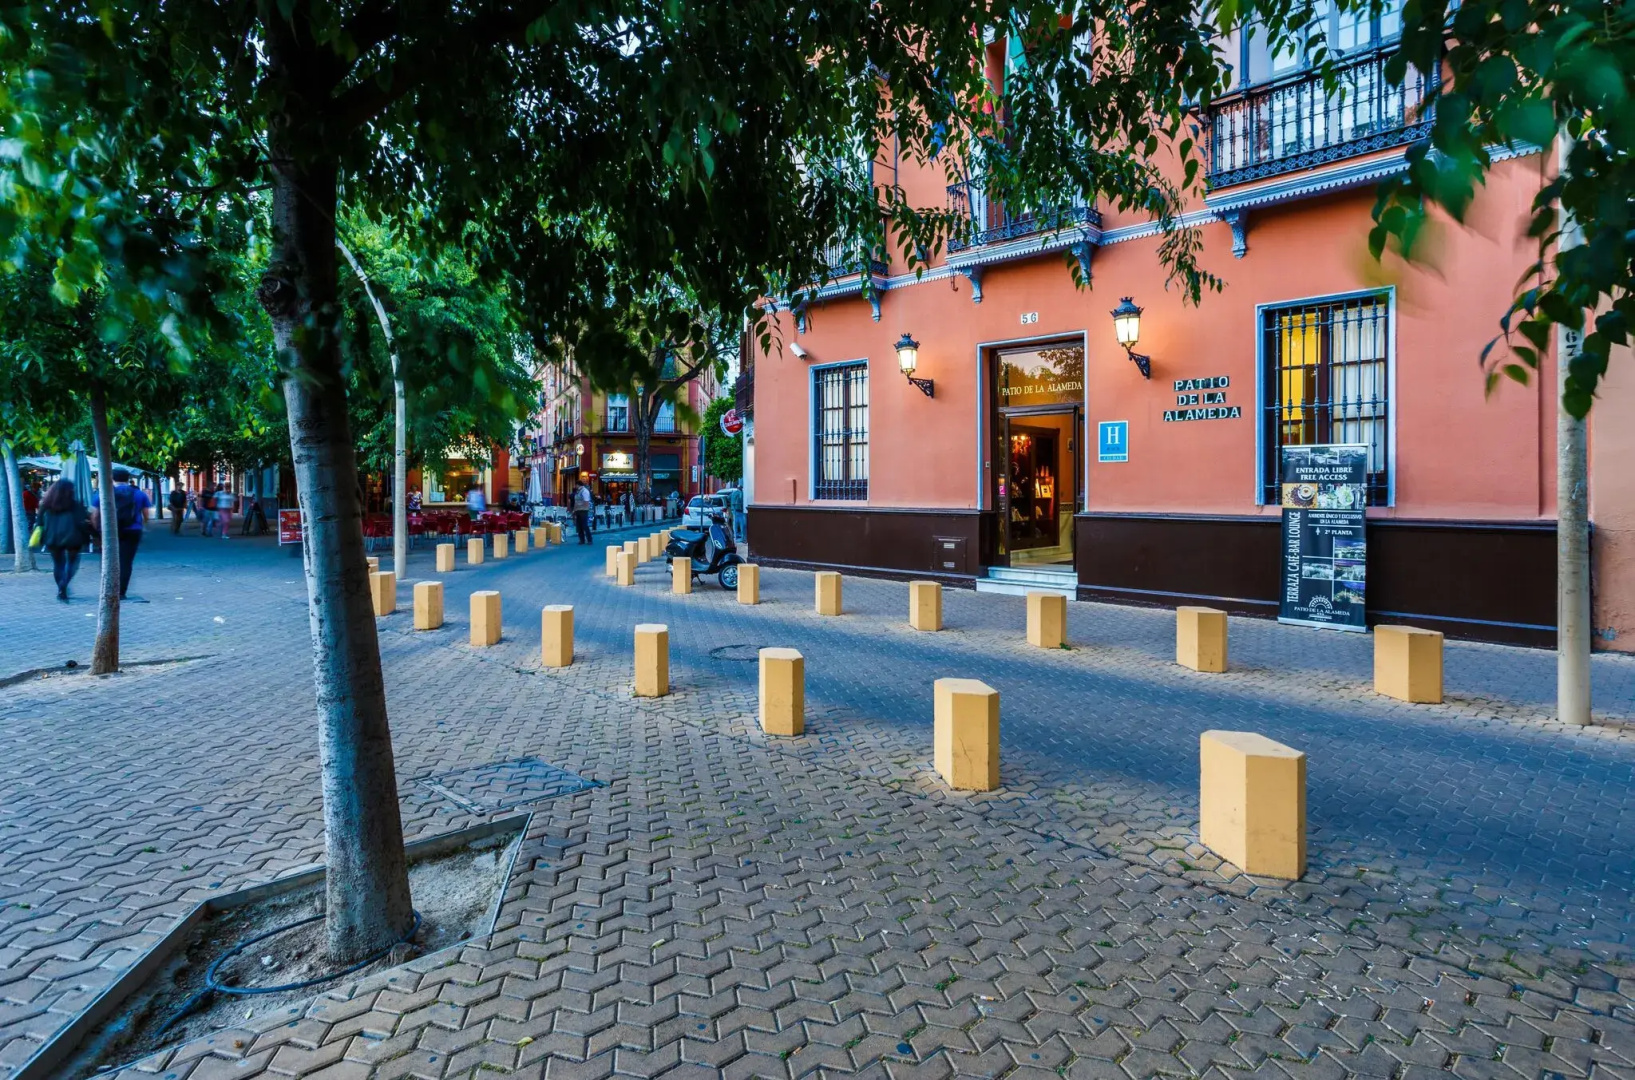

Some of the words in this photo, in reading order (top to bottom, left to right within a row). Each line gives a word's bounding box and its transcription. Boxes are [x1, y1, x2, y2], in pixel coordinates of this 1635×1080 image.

[1022, 312, 1037, 324] 56
[1002, 386, 1022, 396] PATIO
[1024, 385, 1034, 394] DE
[1035, 384, 1045, 393] LA
[1047, 381, 1083, 392] ALAMEDA
[1175, 376, 1229, 391] PATIO
[1178, 394, 1198, 406] DE
[1203, 392, 1225, 405] LA
[1164, 406, 1240, 422] ALAMEDA
[1105, 426, 1121, 445] H
[1295, 466, 1330, 474] ENTRADA
[1288, 511, 1301, 538] LOUNGE
[1285, 539, 1300, 572] CAFÉ-BAR
[1287, 573, 1300, 603] TERRAZA
